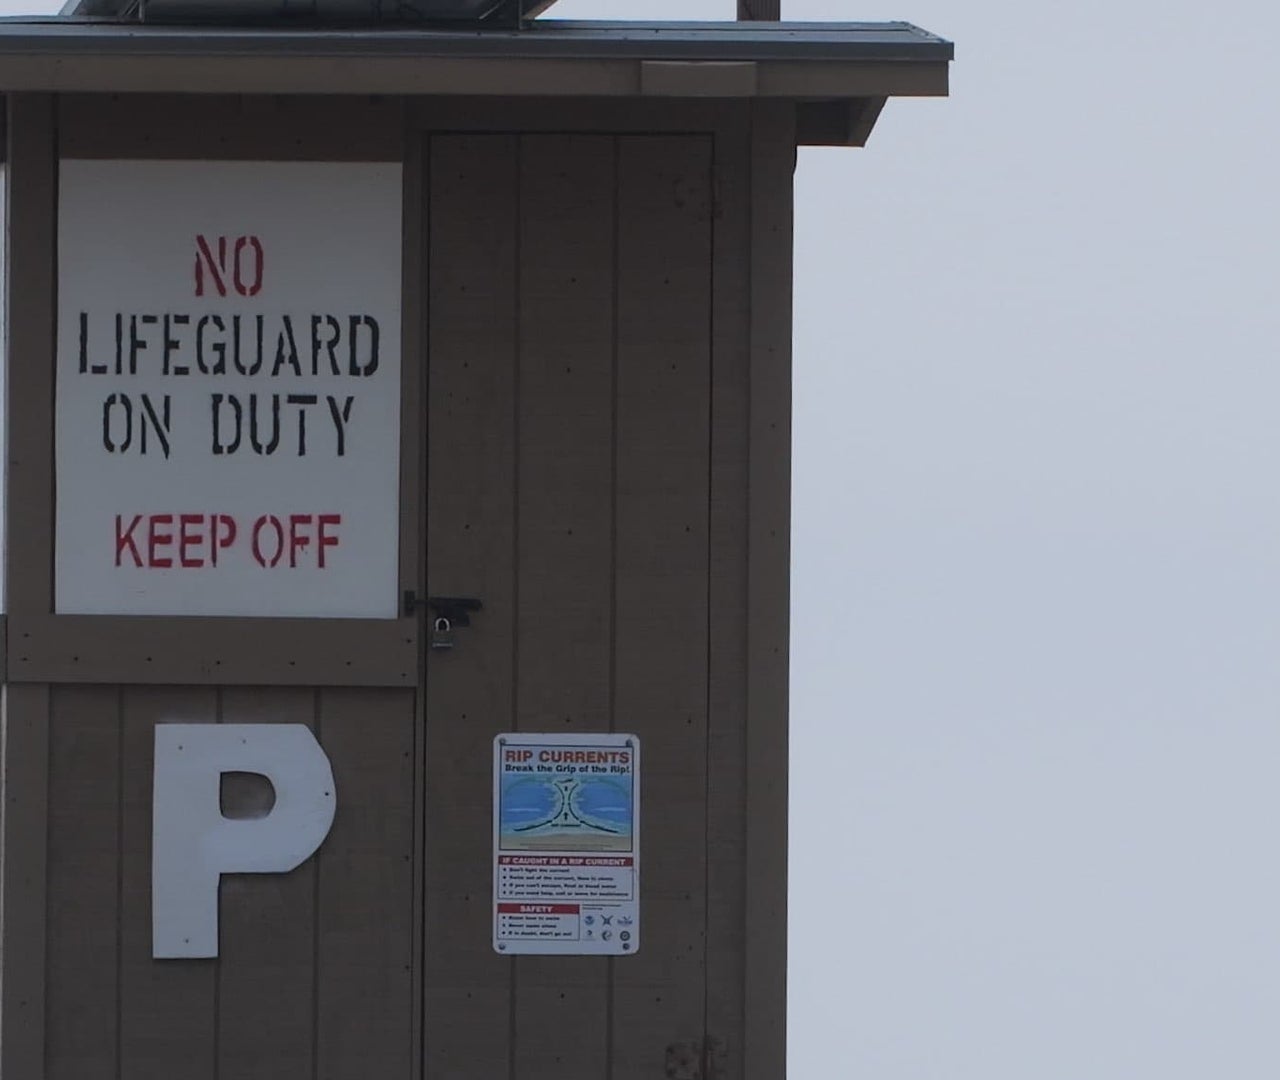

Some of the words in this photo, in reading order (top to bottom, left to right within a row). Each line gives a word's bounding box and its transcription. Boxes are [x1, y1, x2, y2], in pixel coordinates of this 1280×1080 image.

[195, 234, 264, 297] NO
[79, 311, 381, 377] LIFEGUARD
[102, 392, 172, 460] ON
[211, 393, 355, 457] DUTY
[114, 513, 238, 569] KEEP
[250, 513, 342, 569] OFF
[505, 750, 533, 763] RIP
[538, 750, 630, 764] CURRENTS
[505, 764, 534, 773] Break
[537, 764, 553, 773] the
[555, 764, 577, 775] Grip
[579, 765, 590, 773] of
[591, 765, 607, 774] the
[151, 723, 337, 960] P
